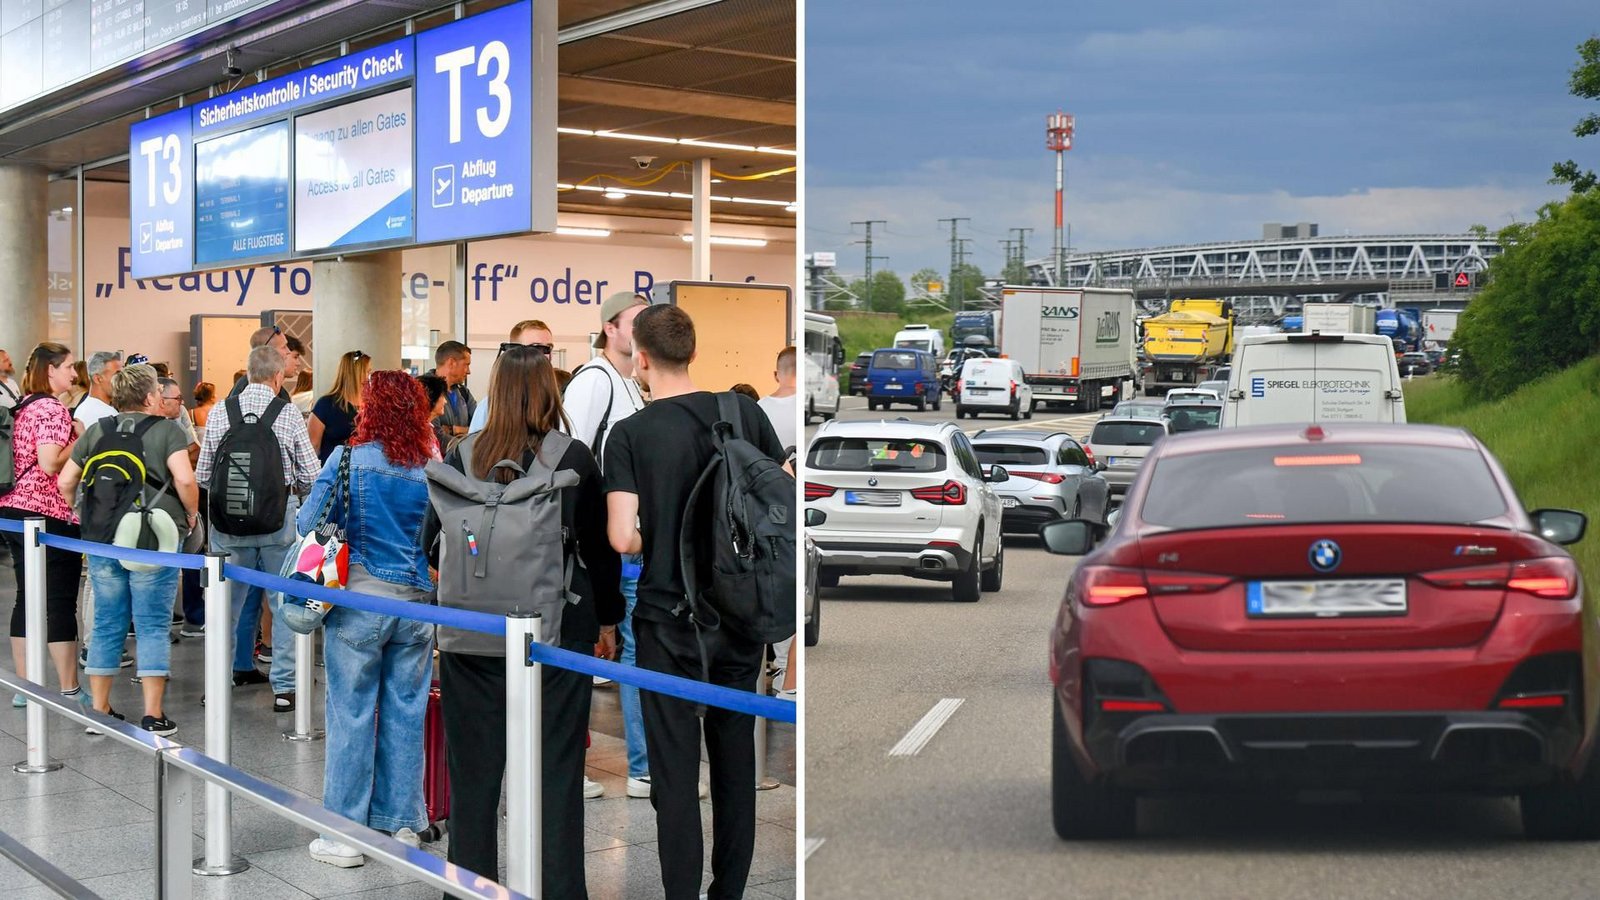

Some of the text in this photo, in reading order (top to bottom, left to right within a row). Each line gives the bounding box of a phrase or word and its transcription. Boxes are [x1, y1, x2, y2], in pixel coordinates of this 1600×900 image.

[200, 81, 300, 127] Sicherheitskontrolle
[309, 66, 359, 95] Security
[362, 49, 404, 80] Check
[434, 40, 512, 144] T3
[337, 126, 349, 141] zu
[351, 119, 374, 138] allen
[376, 112, 407, 132] Gates
[140, 133, 182, 207] T3
[353, 171, 363, 188] all
[366, 168, 396, 186] Gates
[461, 158, 496, 179] Abflug
[461, 183, 514, 206] Departure
[155, 237, 183, 253] Departure
[232, 232, 285, 252] ALLE FLUGSTEIGE
[529, 267, 609, 305] oder
[1267, 380, 1370, 389] SPIEGEL ELEKTROTECHNIK
[226, 452, 251, 516] PUMA
